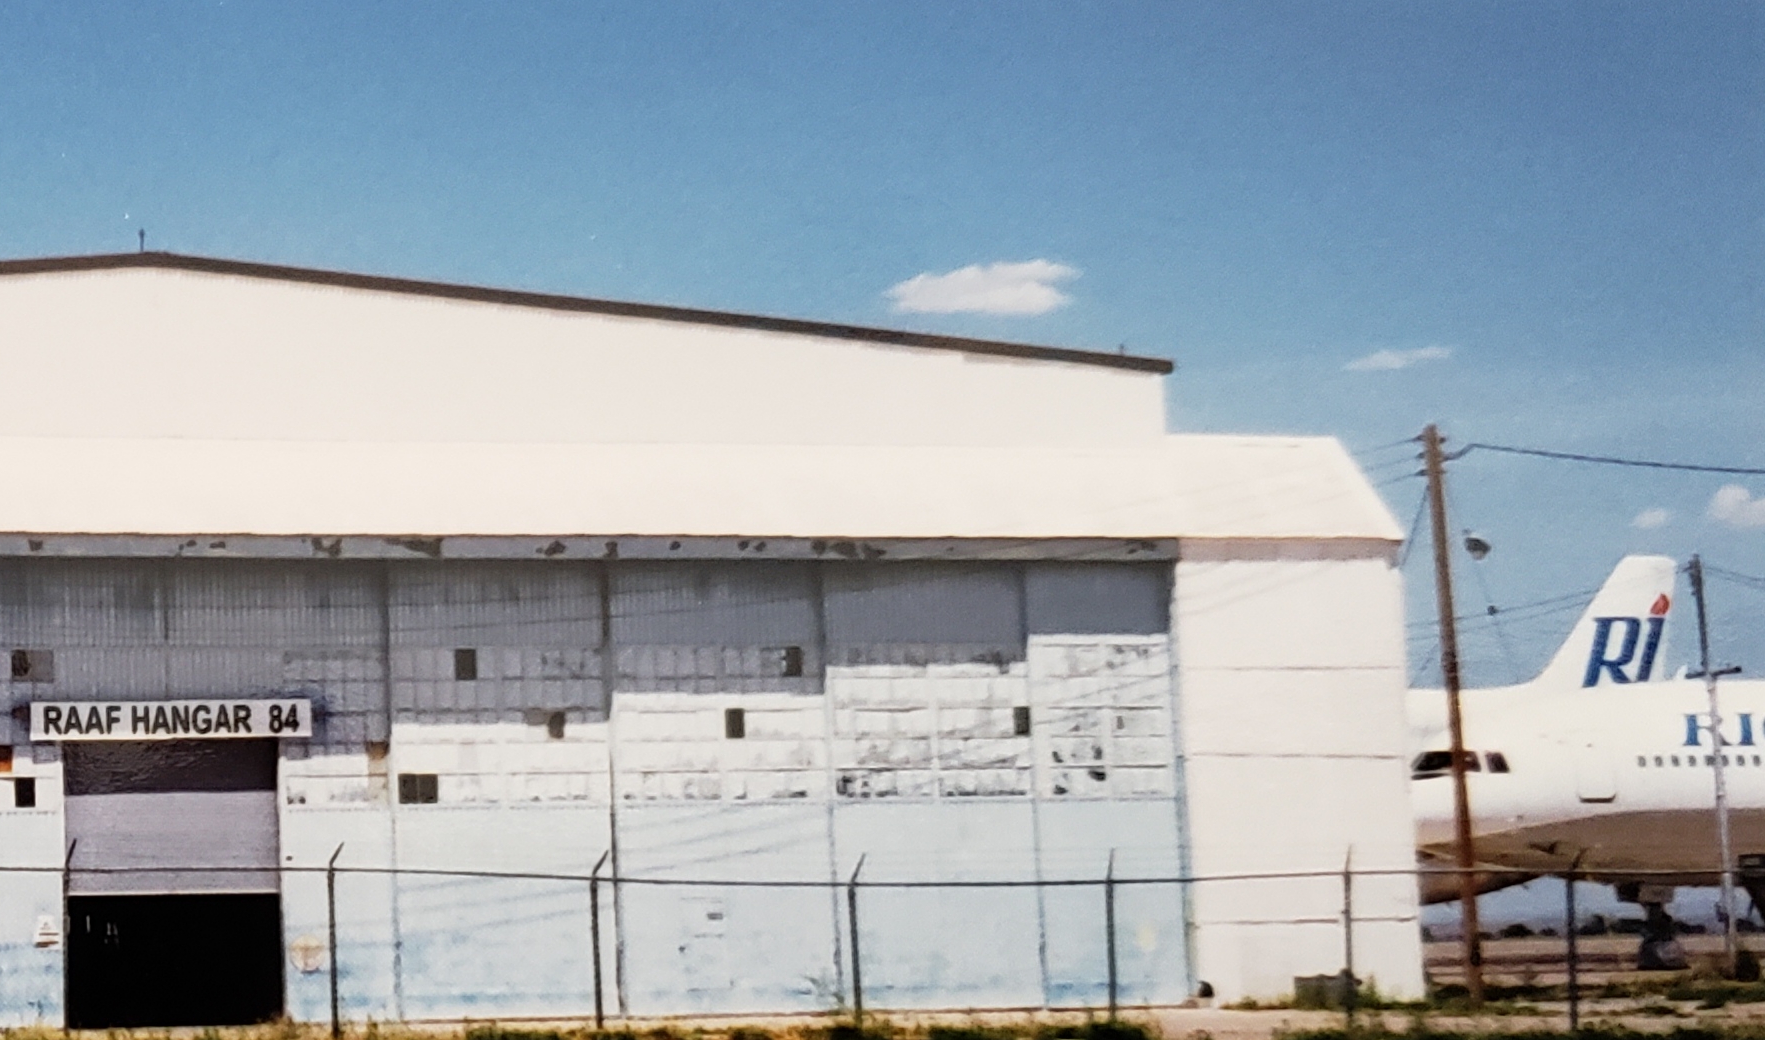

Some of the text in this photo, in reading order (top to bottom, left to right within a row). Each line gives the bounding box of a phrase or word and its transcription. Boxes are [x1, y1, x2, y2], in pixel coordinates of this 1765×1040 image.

[44, 703, 300, 735] RAAF HANGAR 84
[1682, 713, 1765, 746] RI
